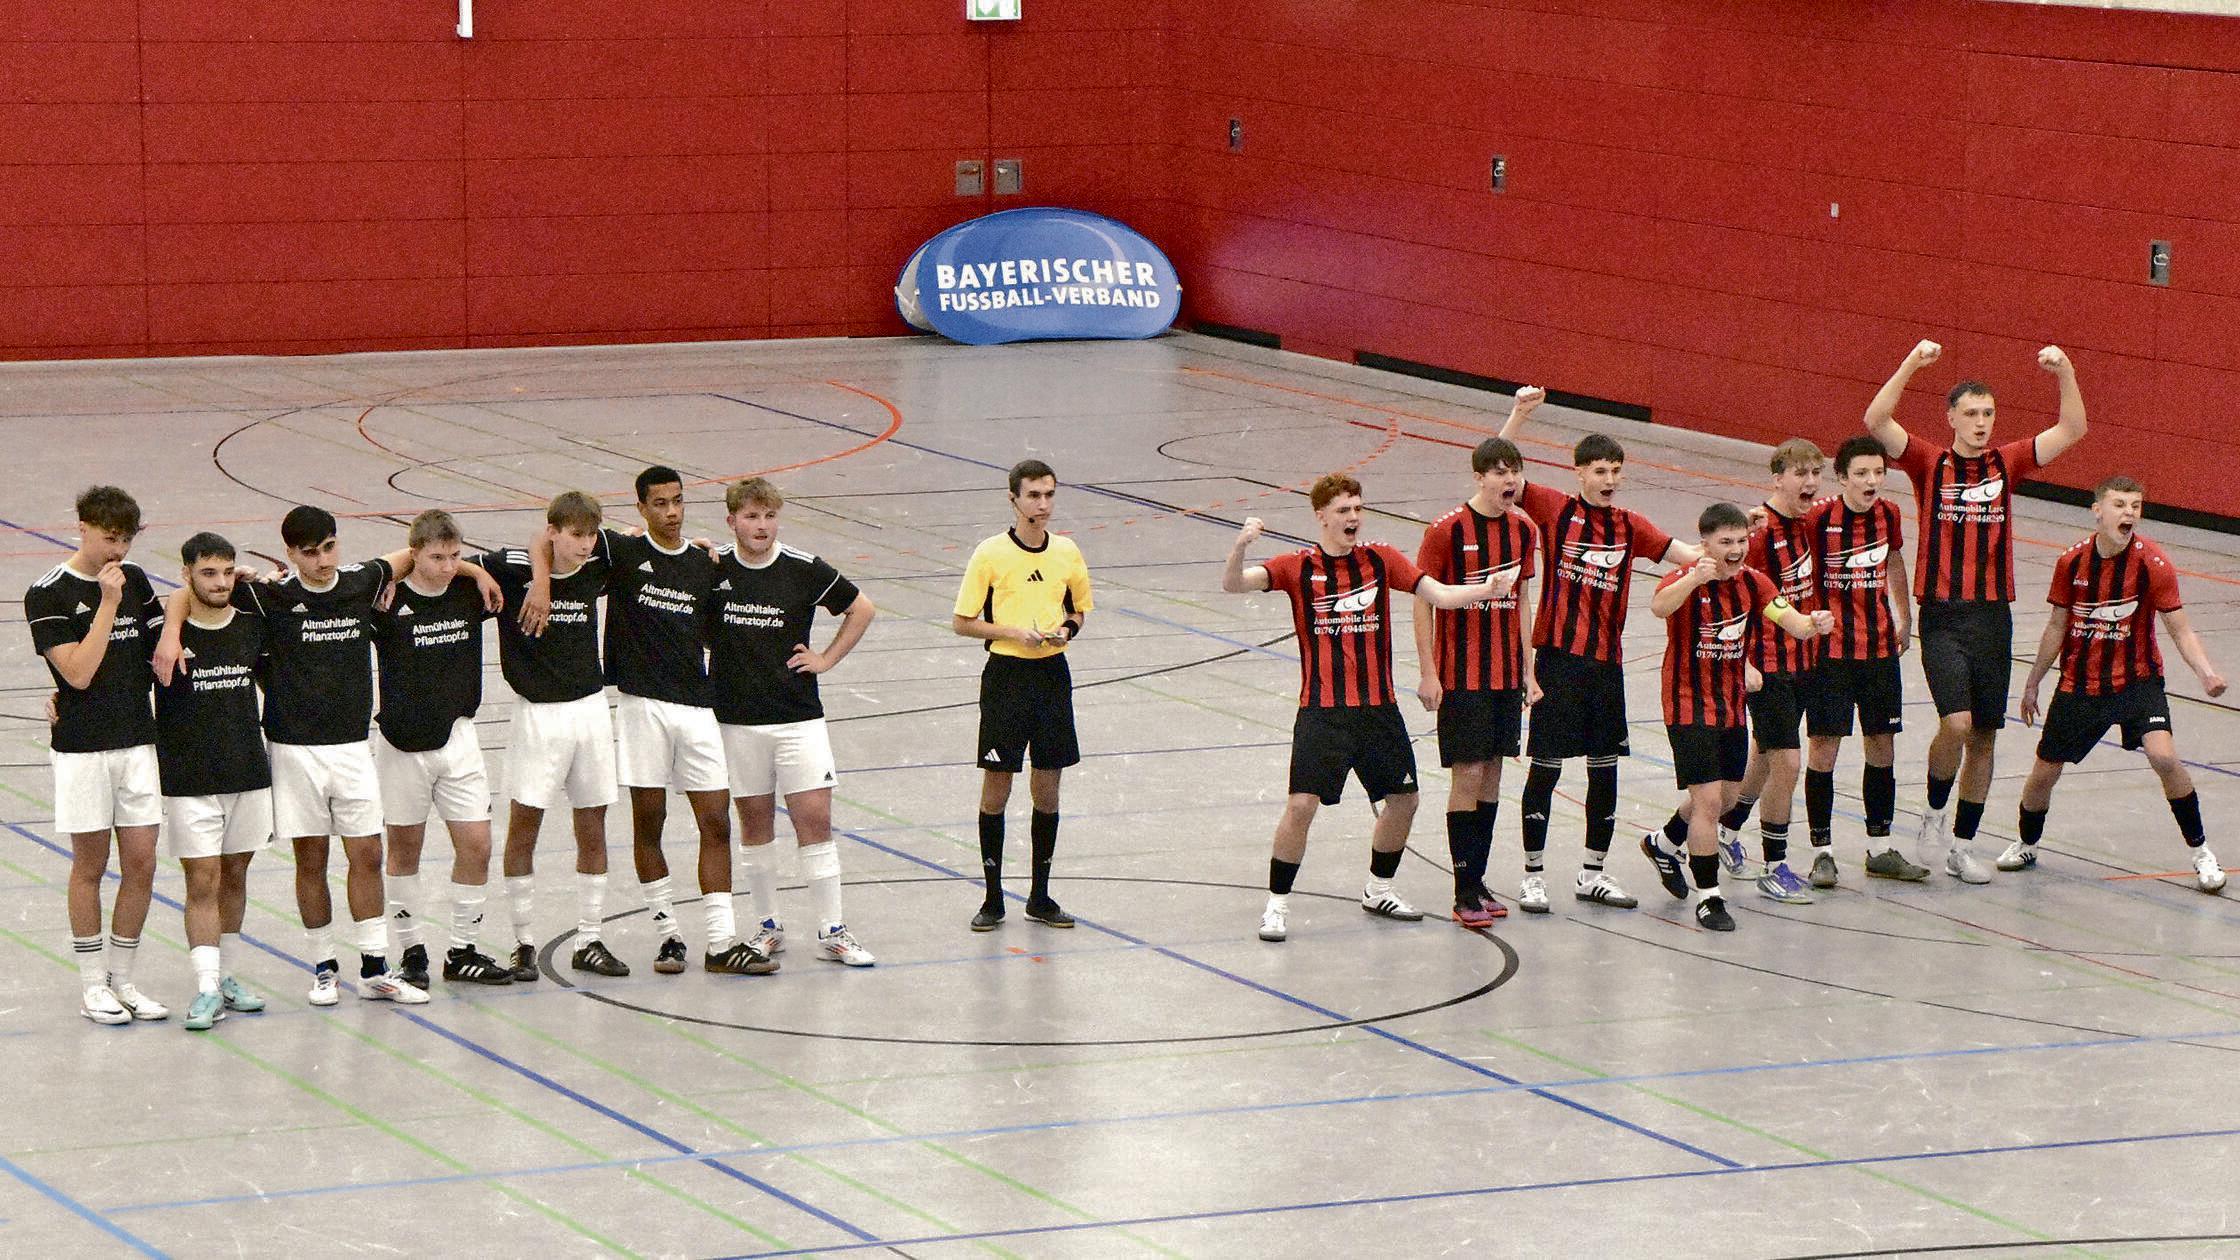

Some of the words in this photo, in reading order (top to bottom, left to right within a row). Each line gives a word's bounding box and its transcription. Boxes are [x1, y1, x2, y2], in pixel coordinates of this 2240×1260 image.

[936, 258, 1157, 289] BAYERISCHER
[940, 286, 1160, 311] FUSSBALL-VERBAND
[1823, 571, 1872, 580] Automobile
[640, 583, 697, 602] Altmühltaler-
[550, 600, 588, 610] ühltaler-
[638, 594, 694, 615] Pflanztopf.de
[724, 601, 785, 615] Altmühltaler-
[302, 617, 360, 630] Altmühltaler-
[413, 619, 469, 635] Altmühltaler-
[723, 613, 784, 629] Pflanztopf.de
[1314, 614, 1361, 625] Automobile
[192, 664, 252, 679] Altmühltaler-
